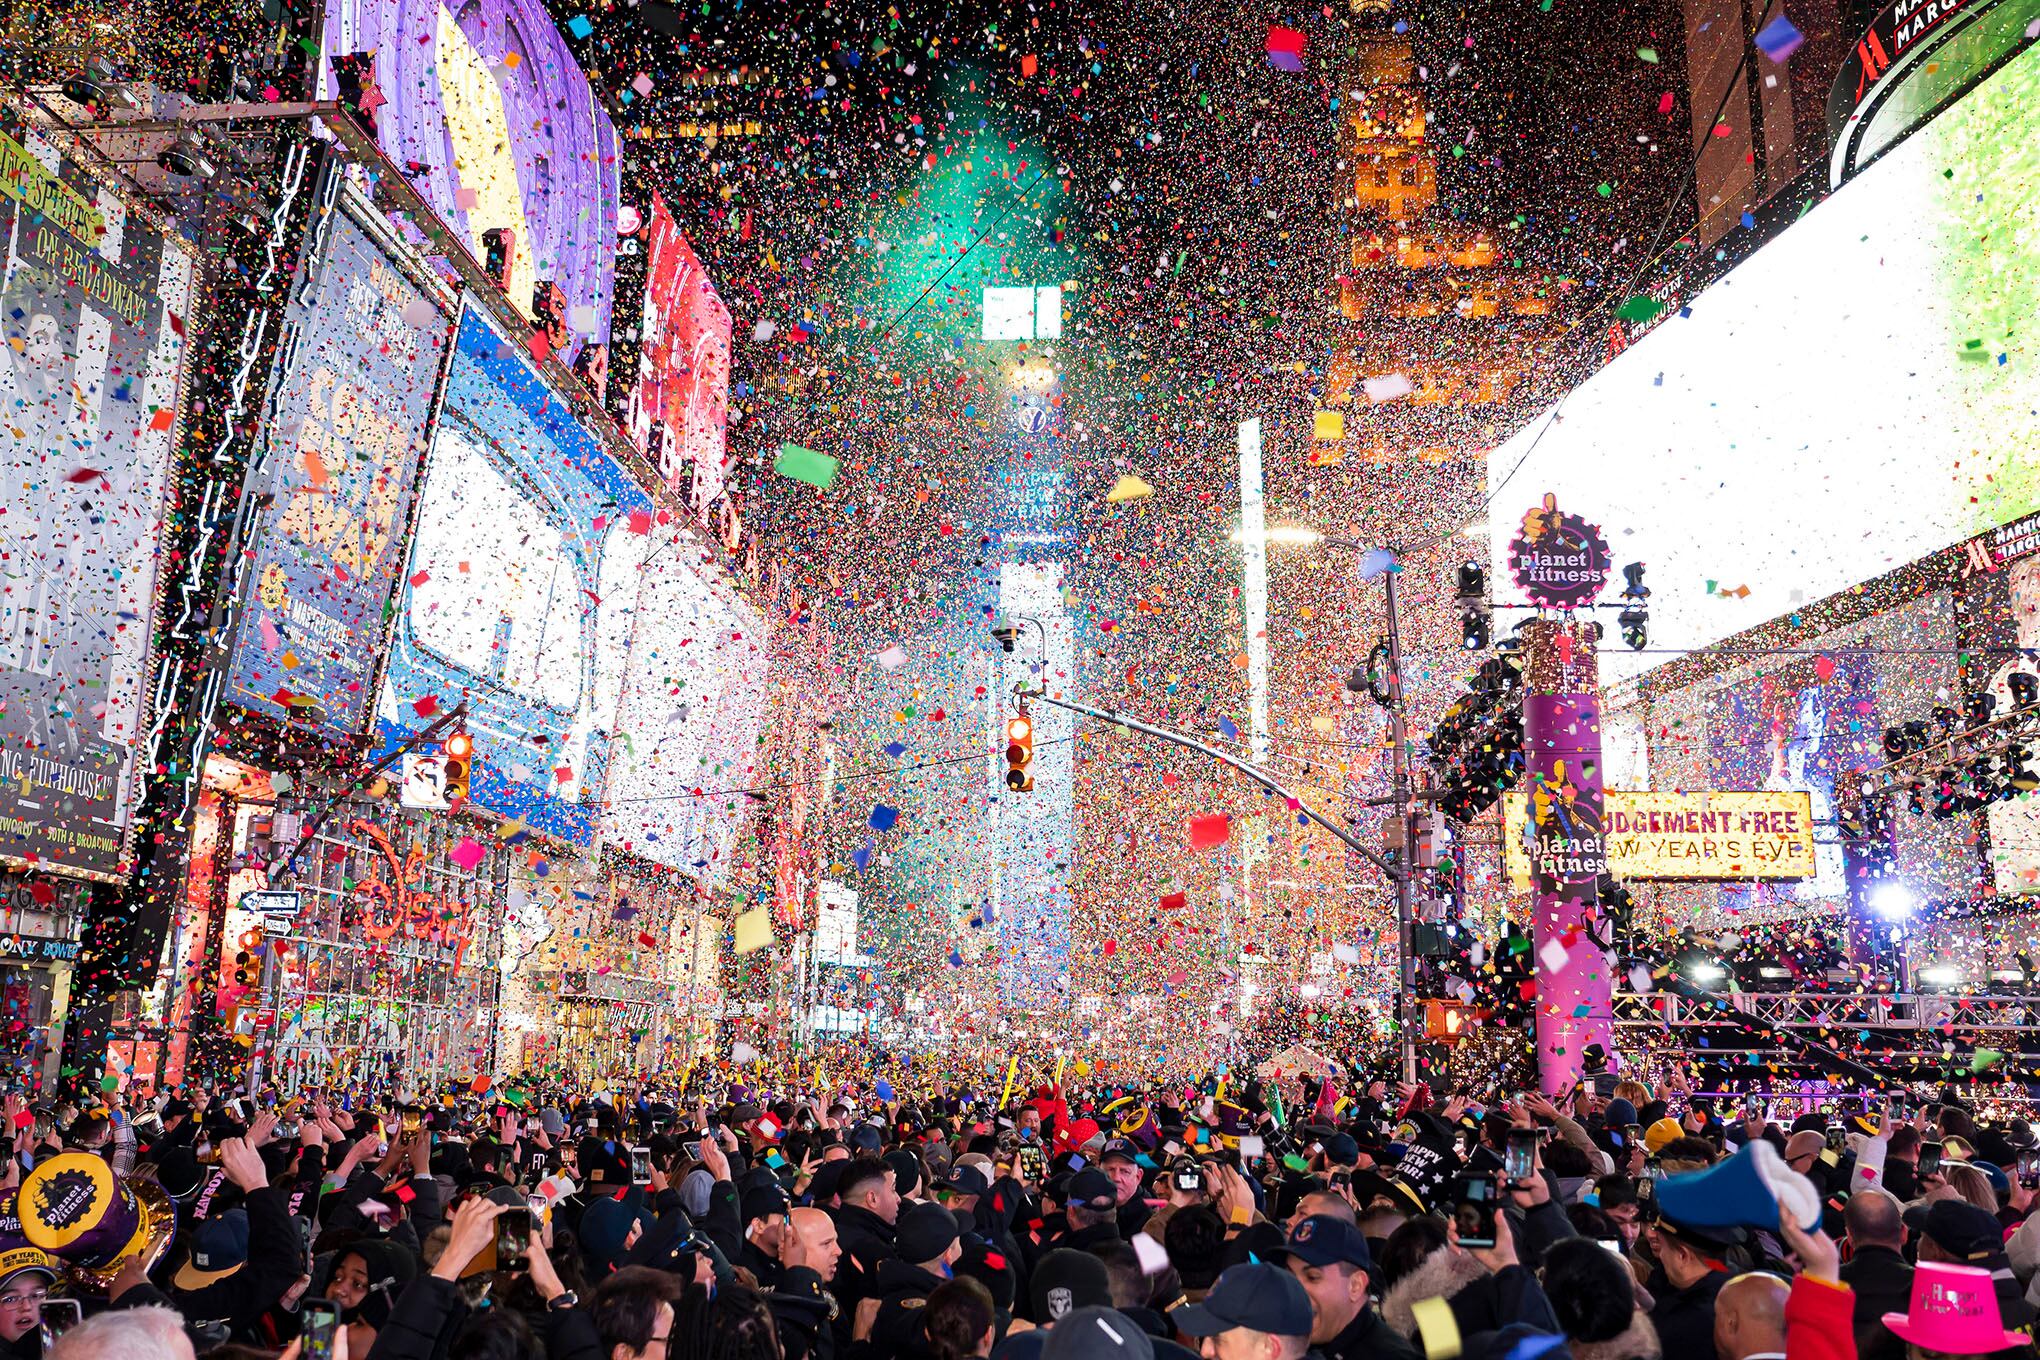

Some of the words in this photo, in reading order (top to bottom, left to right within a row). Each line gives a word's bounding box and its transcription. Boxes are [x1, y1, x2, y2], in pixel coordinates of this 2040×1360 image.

[36, 227, 59, 266] ON
[1519, 551, 1586, 571] planet
[1529, 567, 1601, 582] fitness
[1602, 811, 1734, 834] UDGEMENT
[1739, 811, 1800, 834] FREE
[1607, 841, 1639, 859] EW
[1651, 841, 1741, 859] YEAR'S
[1752, 841, 1802, 859] EVE
[1396, 1162, 1424, 1180] EAR!
[46, 1184, 82, 1225] planet
[57, 1184, 95, 1225] fitness
[0, 1216, 20, 1228] pla
